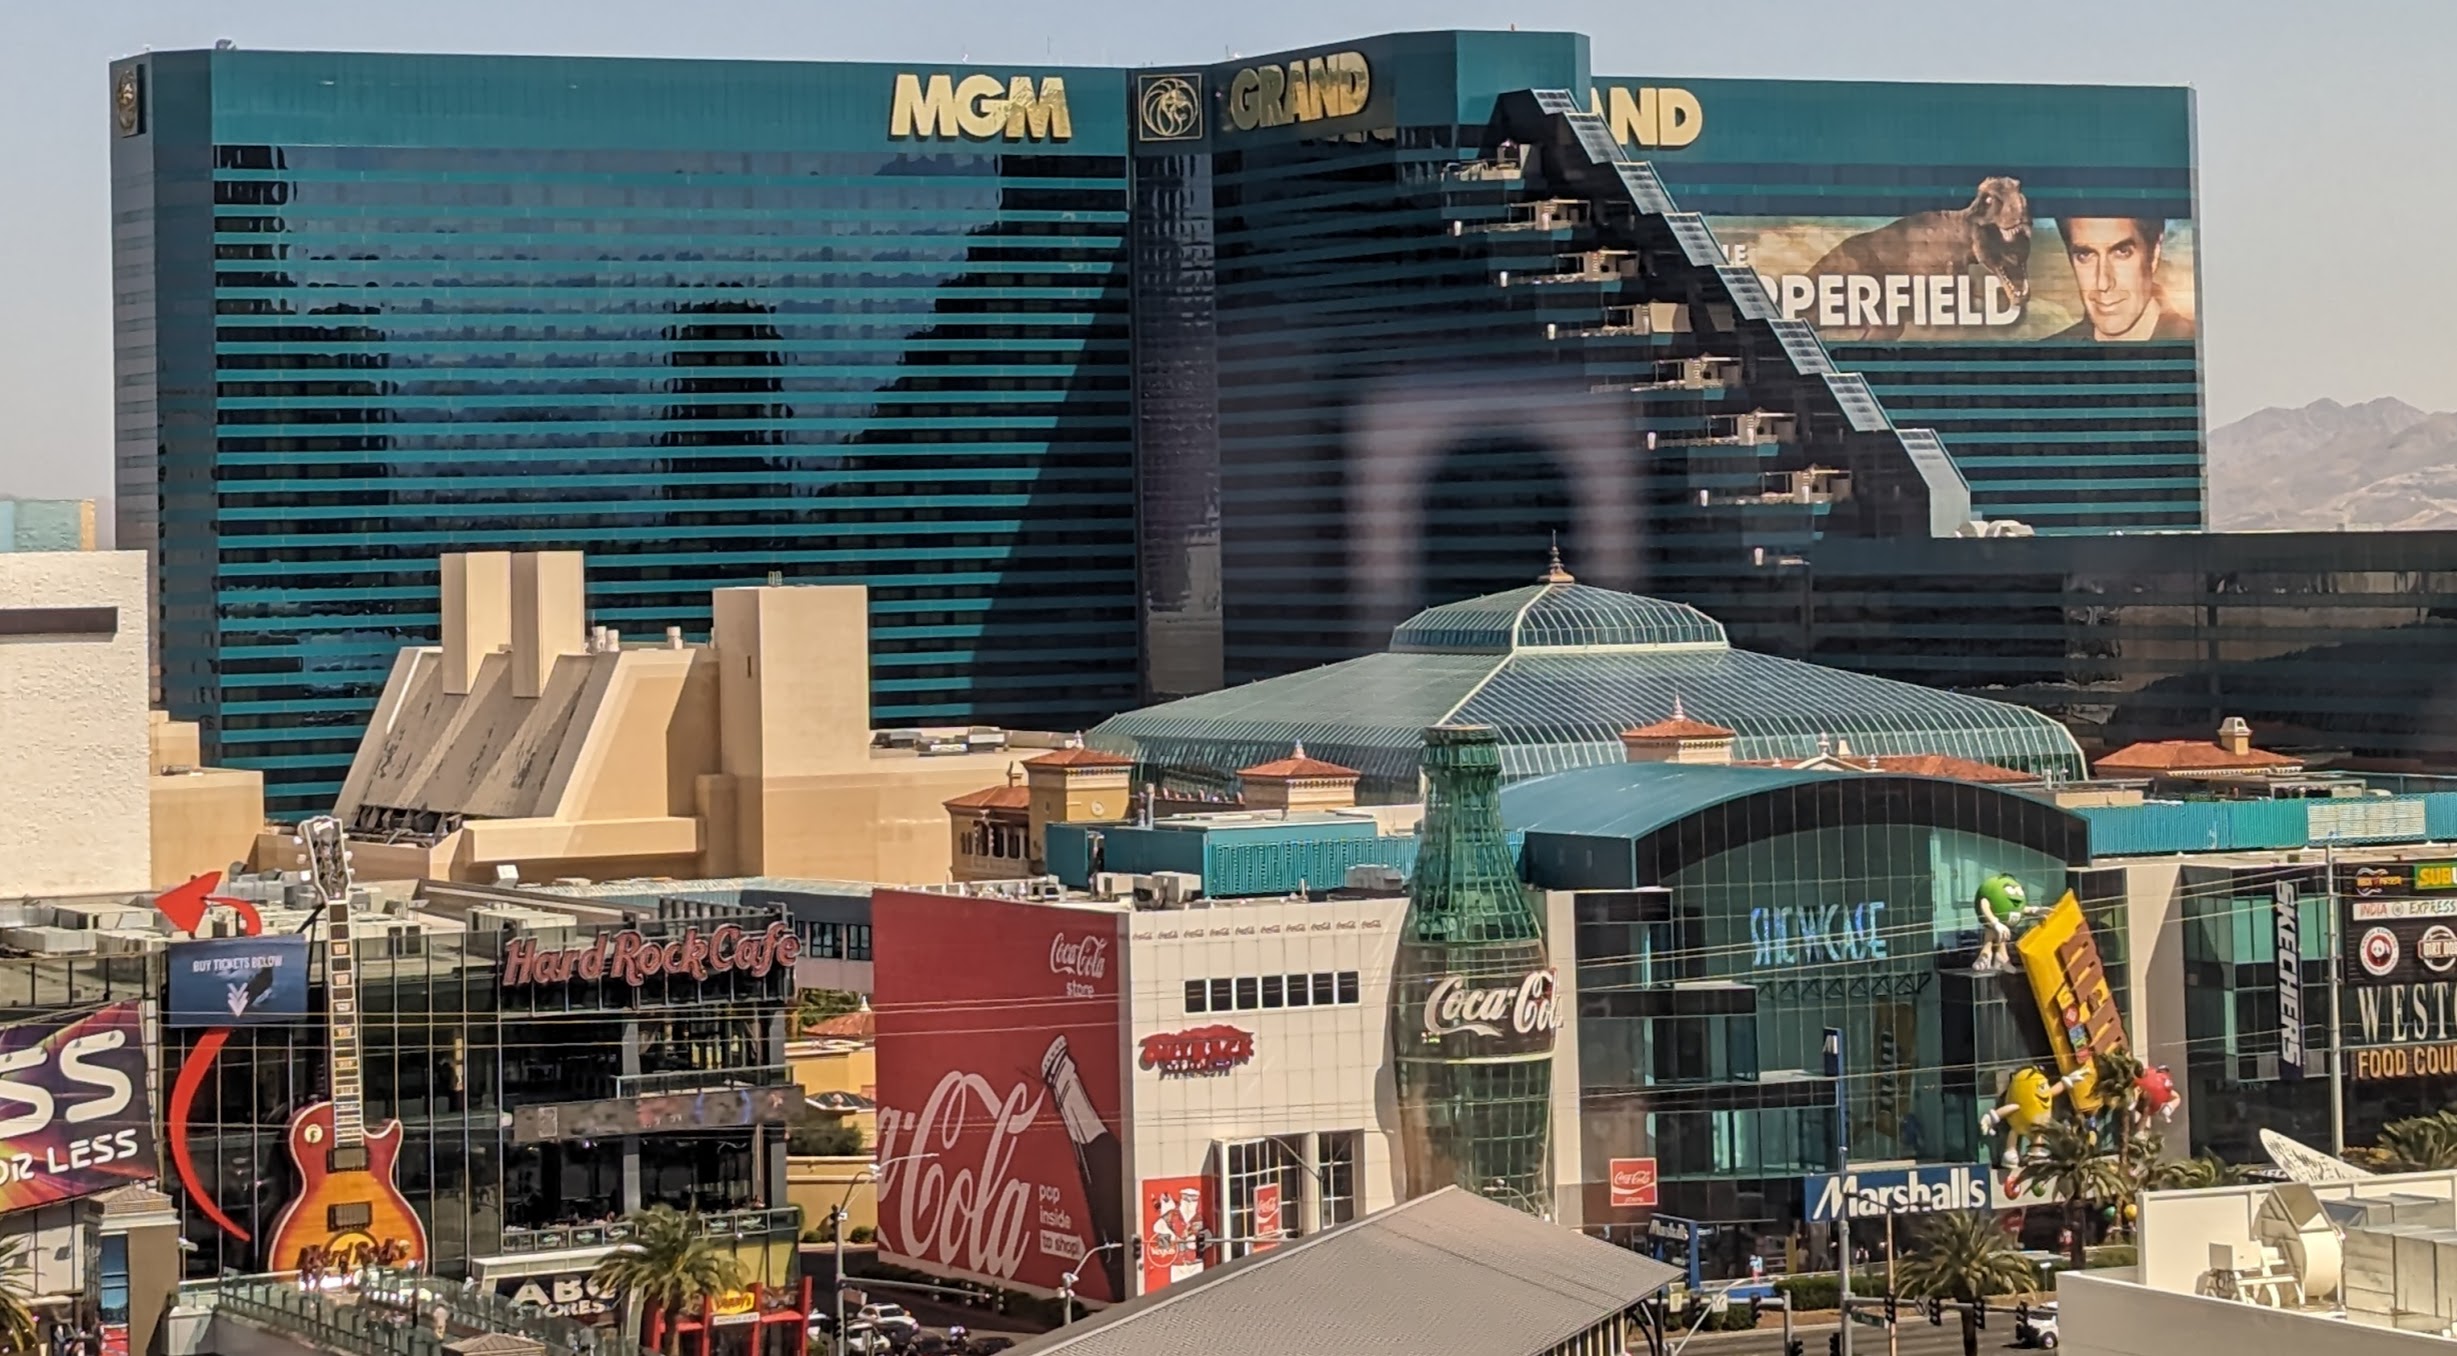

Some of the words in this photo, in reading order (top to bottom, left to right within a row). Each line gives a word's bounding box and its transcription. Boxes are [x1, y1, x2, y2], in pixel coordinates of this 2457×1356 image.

[889, 73, 1072, 141] MGM
[1230, 51, 1370, 131] GRAND
[1591, 86, 1703, 148] ND
[2359, 903, 2388, 917] INDIA
[2409, 900, 2456, 915] EXPRESS
[192, 959, 212, 973] BUY
[213, 956, 250, 971] TICKETS
[251, 955, 283, 969] BELOW
[502, 930, 611, 987] Hard
[611, 926, 709, 987] Rock
[709, 921, 803, 978] Cafe
[1050, 932, 1108, 979] Coca-Cola
[2275, 879, 2302, 1067] SKECHERS
[2357, 982, 2457, 1044] WEST
[2358, 1048, 2407, 1079] FOOD
[47, 1128, 138, 1175] LESS
[1039, 1184, 1060, 1205] pop
[1812, 1167, 1987, 1220] Marshalls
[1039, 1205, 1072, 1230] inside
[1042, 1233, 1053, 1249] to
